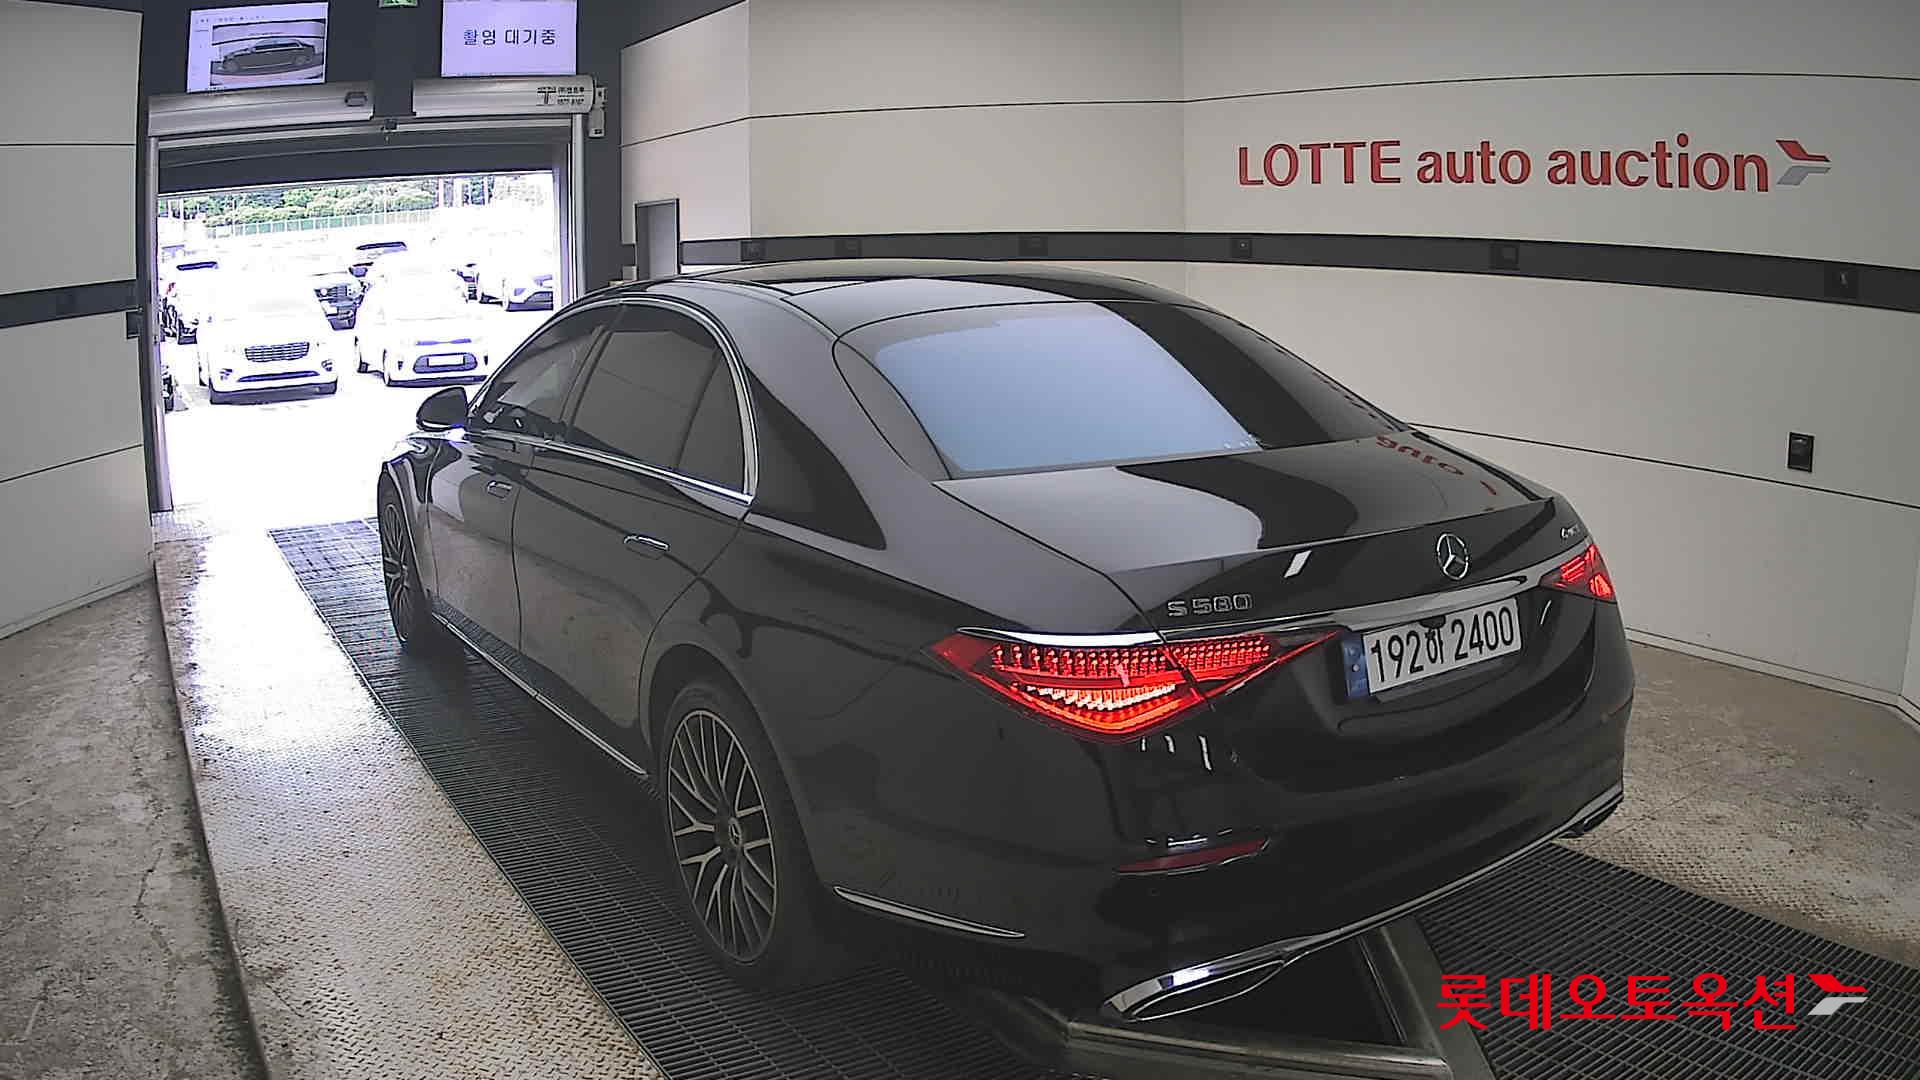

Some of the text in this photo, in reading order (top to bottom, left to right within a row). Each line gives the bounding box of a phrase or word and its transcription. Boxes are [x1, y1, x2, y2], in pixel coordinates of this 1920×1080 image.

[463, 28, 556, 46] 촬영 대기중
[1238, 133, 1770, 193] LOTTE auto auction
[1167, 593, 1254, 617] S 580
[1450, 605, 1515, 662] 2400
